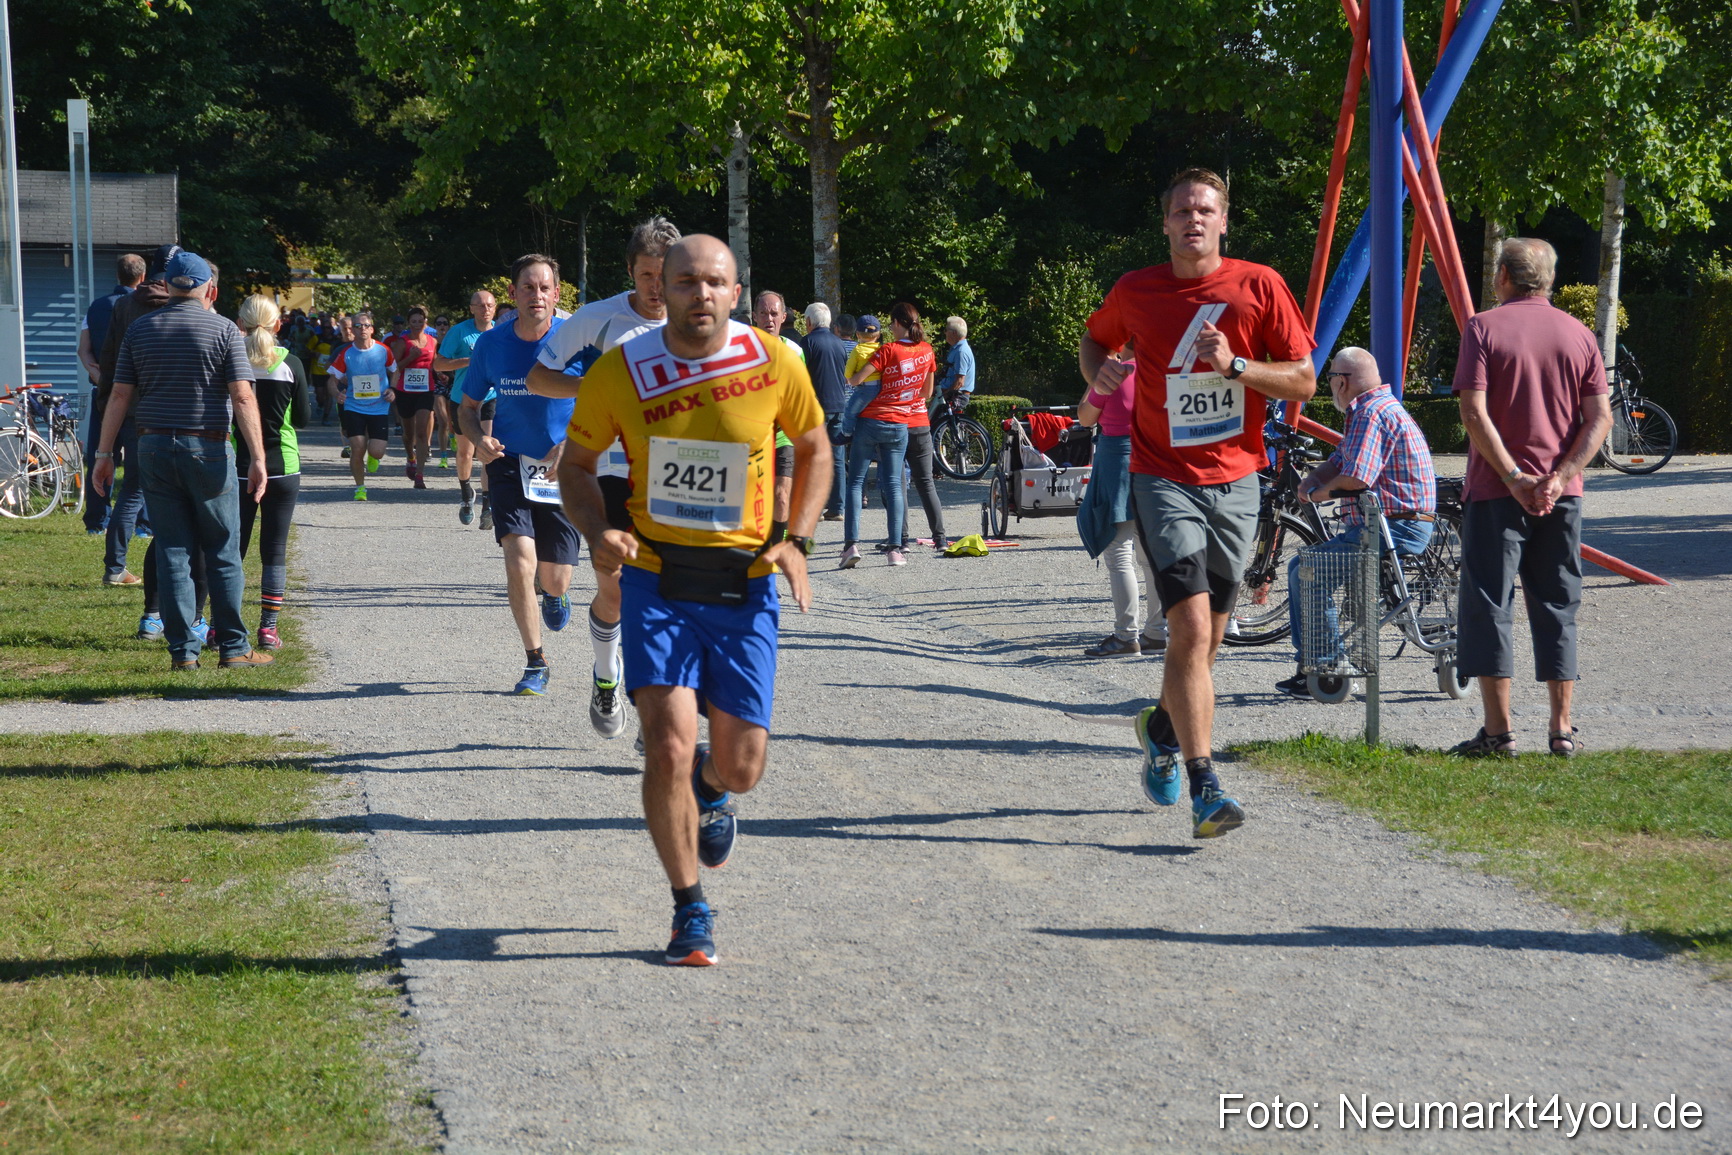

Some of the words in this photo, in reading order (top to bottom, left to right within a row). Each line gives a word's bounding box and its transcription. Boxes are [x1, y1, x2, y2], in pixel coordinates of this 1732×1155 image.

[407, 374, 425, 382] 2557
[361, 382, 372, 390] 73
[500, 387, 536, 396] Pettenho
[643, 392, 705, 425] MAX
[710, 372, 778, 403] BÖGL
[1179, 388, 1234, 416] 2614
[1189, 423, 1228, 438] Matthias
[677, 447, 720, 459] BOCK
[527, 464, 549, 480] 23
[663, 462, 728, 493] 2421
[676, 503, 715, 520] Robert
